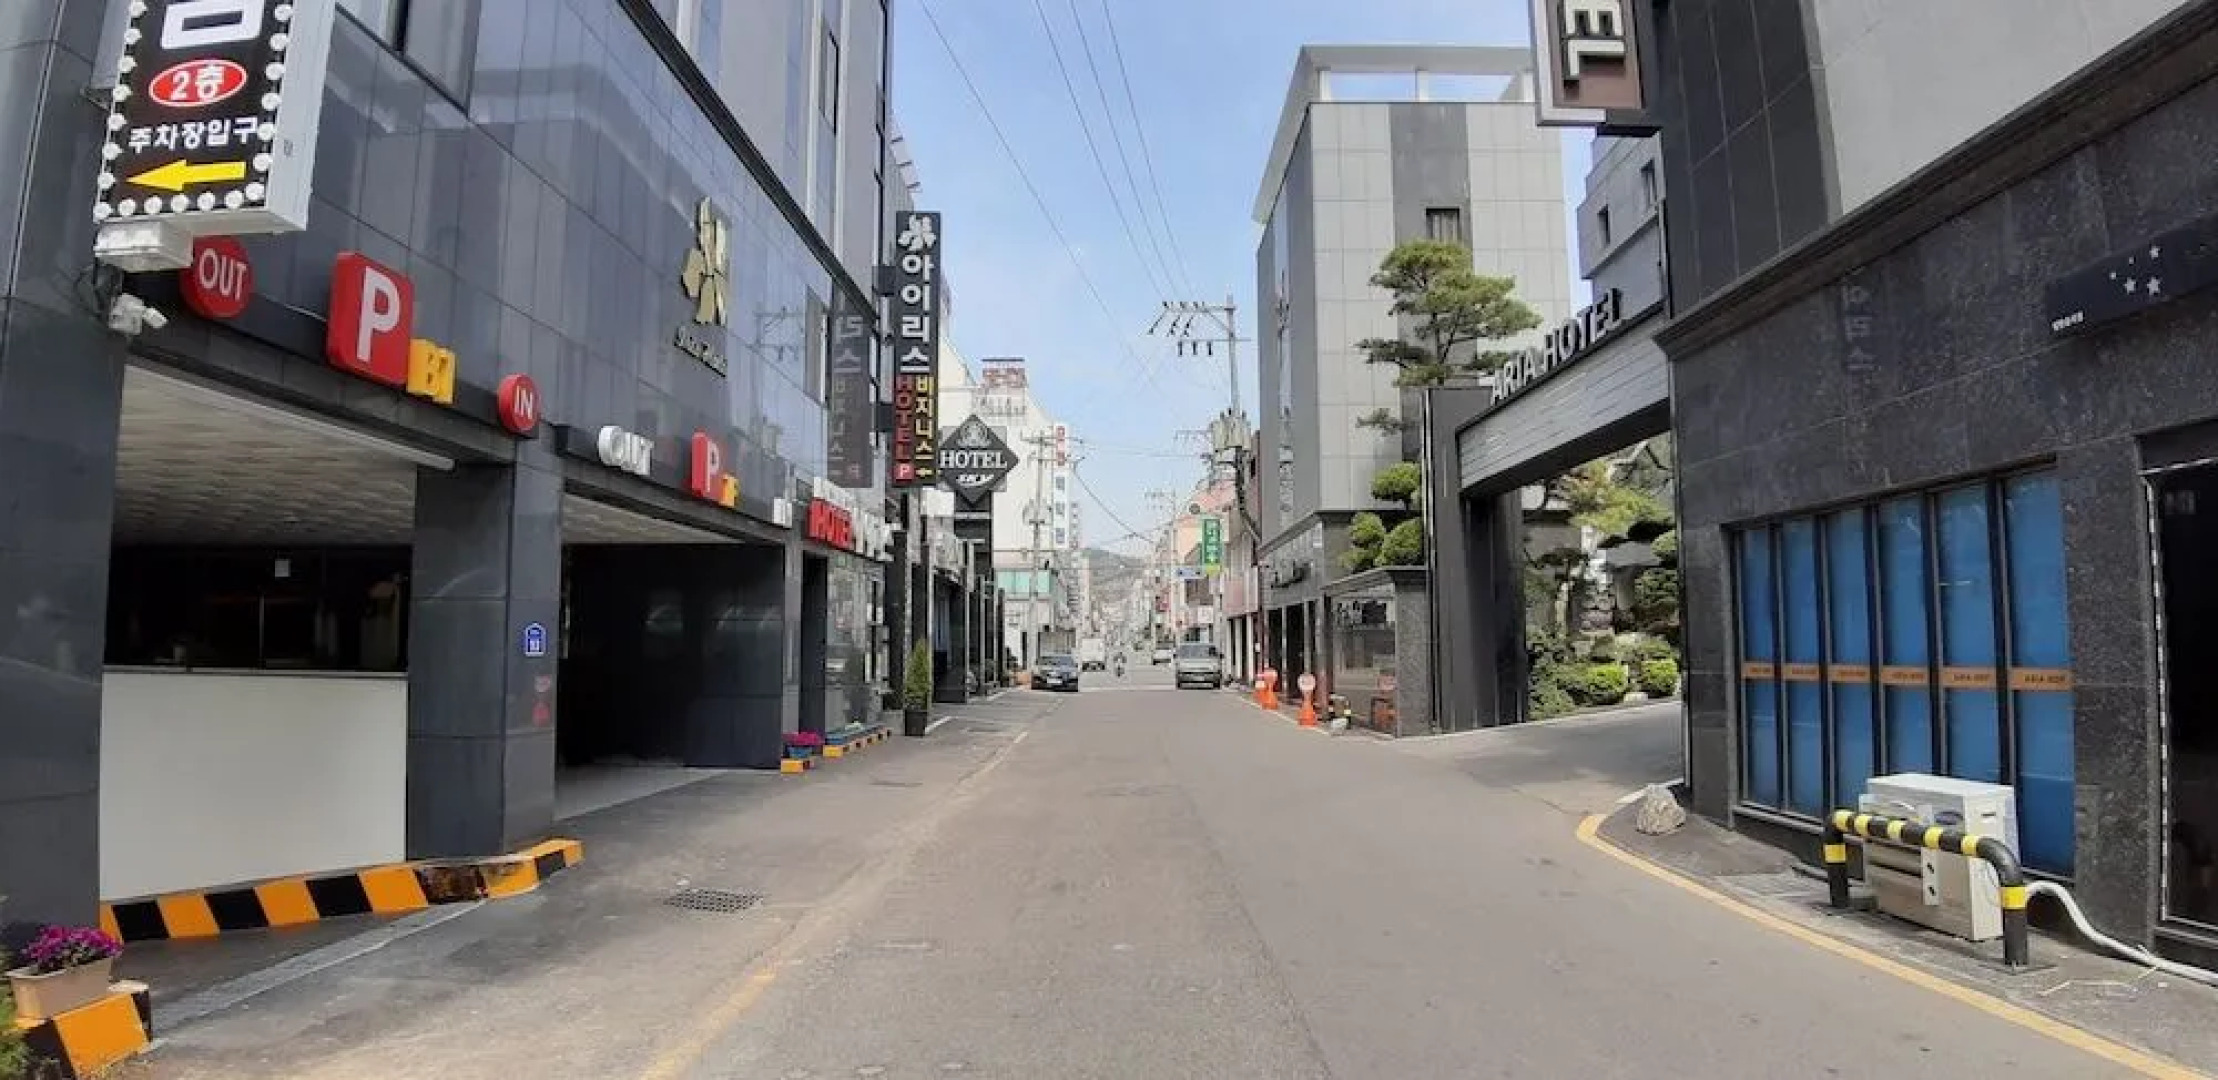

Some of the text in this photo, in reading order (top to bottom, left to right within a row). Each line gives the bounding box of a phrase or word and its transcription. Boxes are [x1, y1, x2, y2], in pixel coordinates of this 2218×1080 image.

[171, 65, 225, 101] 2층
[128, 116, 259, 154] 주차장입구
[198, 248, 247, 301] OUT
[357, 266, 400, 361] P
[901, 254, 935, 374] 아이리스
[1490, 288, 1623, 407] ARIA HOTEL
[513, 387, 534, 419] IN
[895, 376, 912, 460] HOTEL
[915, 376, 935, 460] 비지니스
[898, 463, 912, 478] P
[939, 450, 1008, 470] HOTEL
